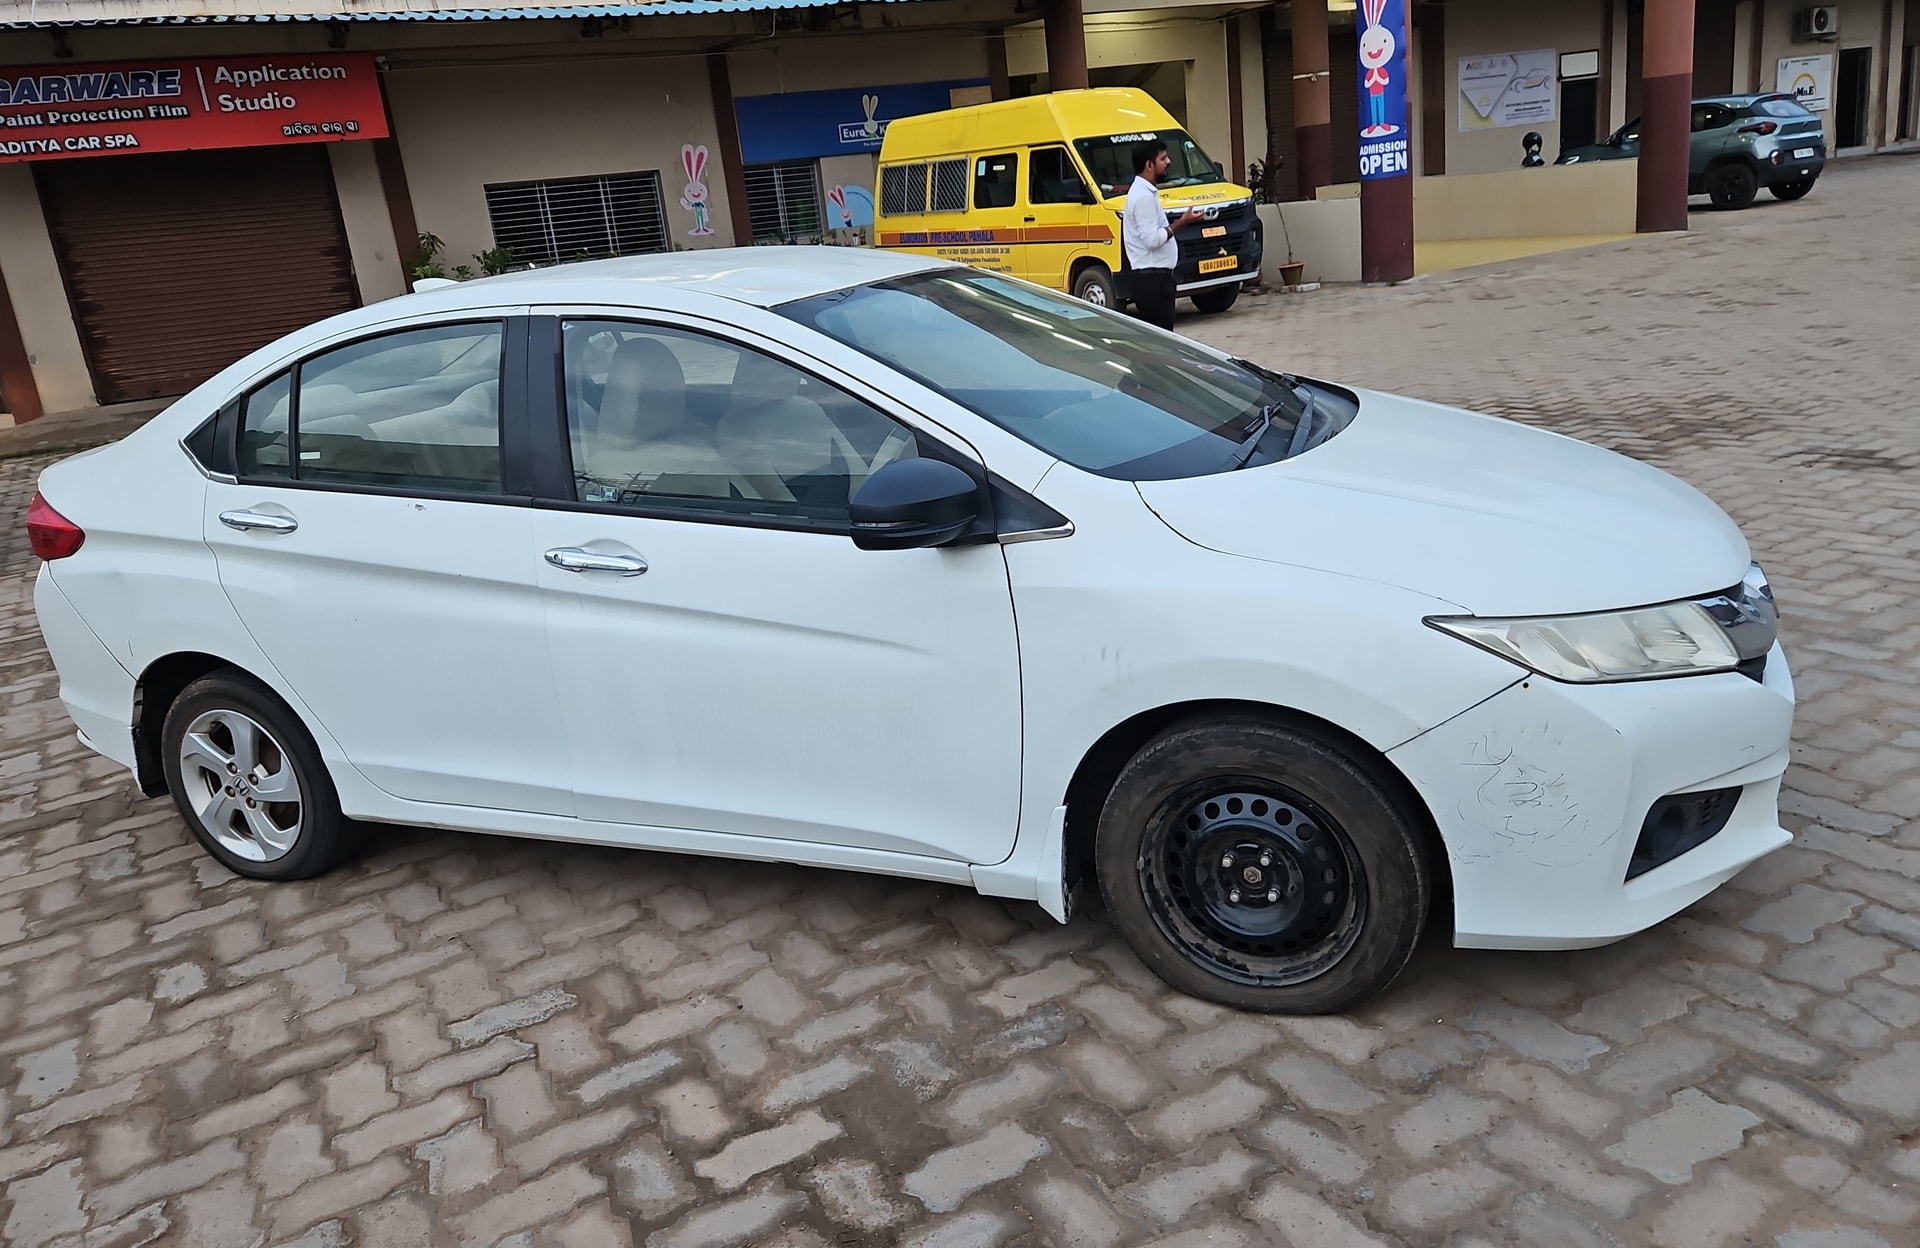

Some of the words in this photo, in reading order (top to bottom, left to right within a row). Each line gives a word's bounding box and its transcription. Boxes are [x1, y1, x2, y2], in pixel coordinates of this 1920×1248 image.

[214, 62, 346, 88] Application
[218, 91, 296, 112] Studio
[47, 107, 144, 124] Protection
[147, 105, 188, 118] Film
[64, 136, 100, 150] CAR
[104, 134, 138, 147] SPA
[1110, 134, 1142, 144] SCHOOL
[1360, 139, 1407, 156] ADMISSION
[1360, 150, 1407, 175] OPEN
